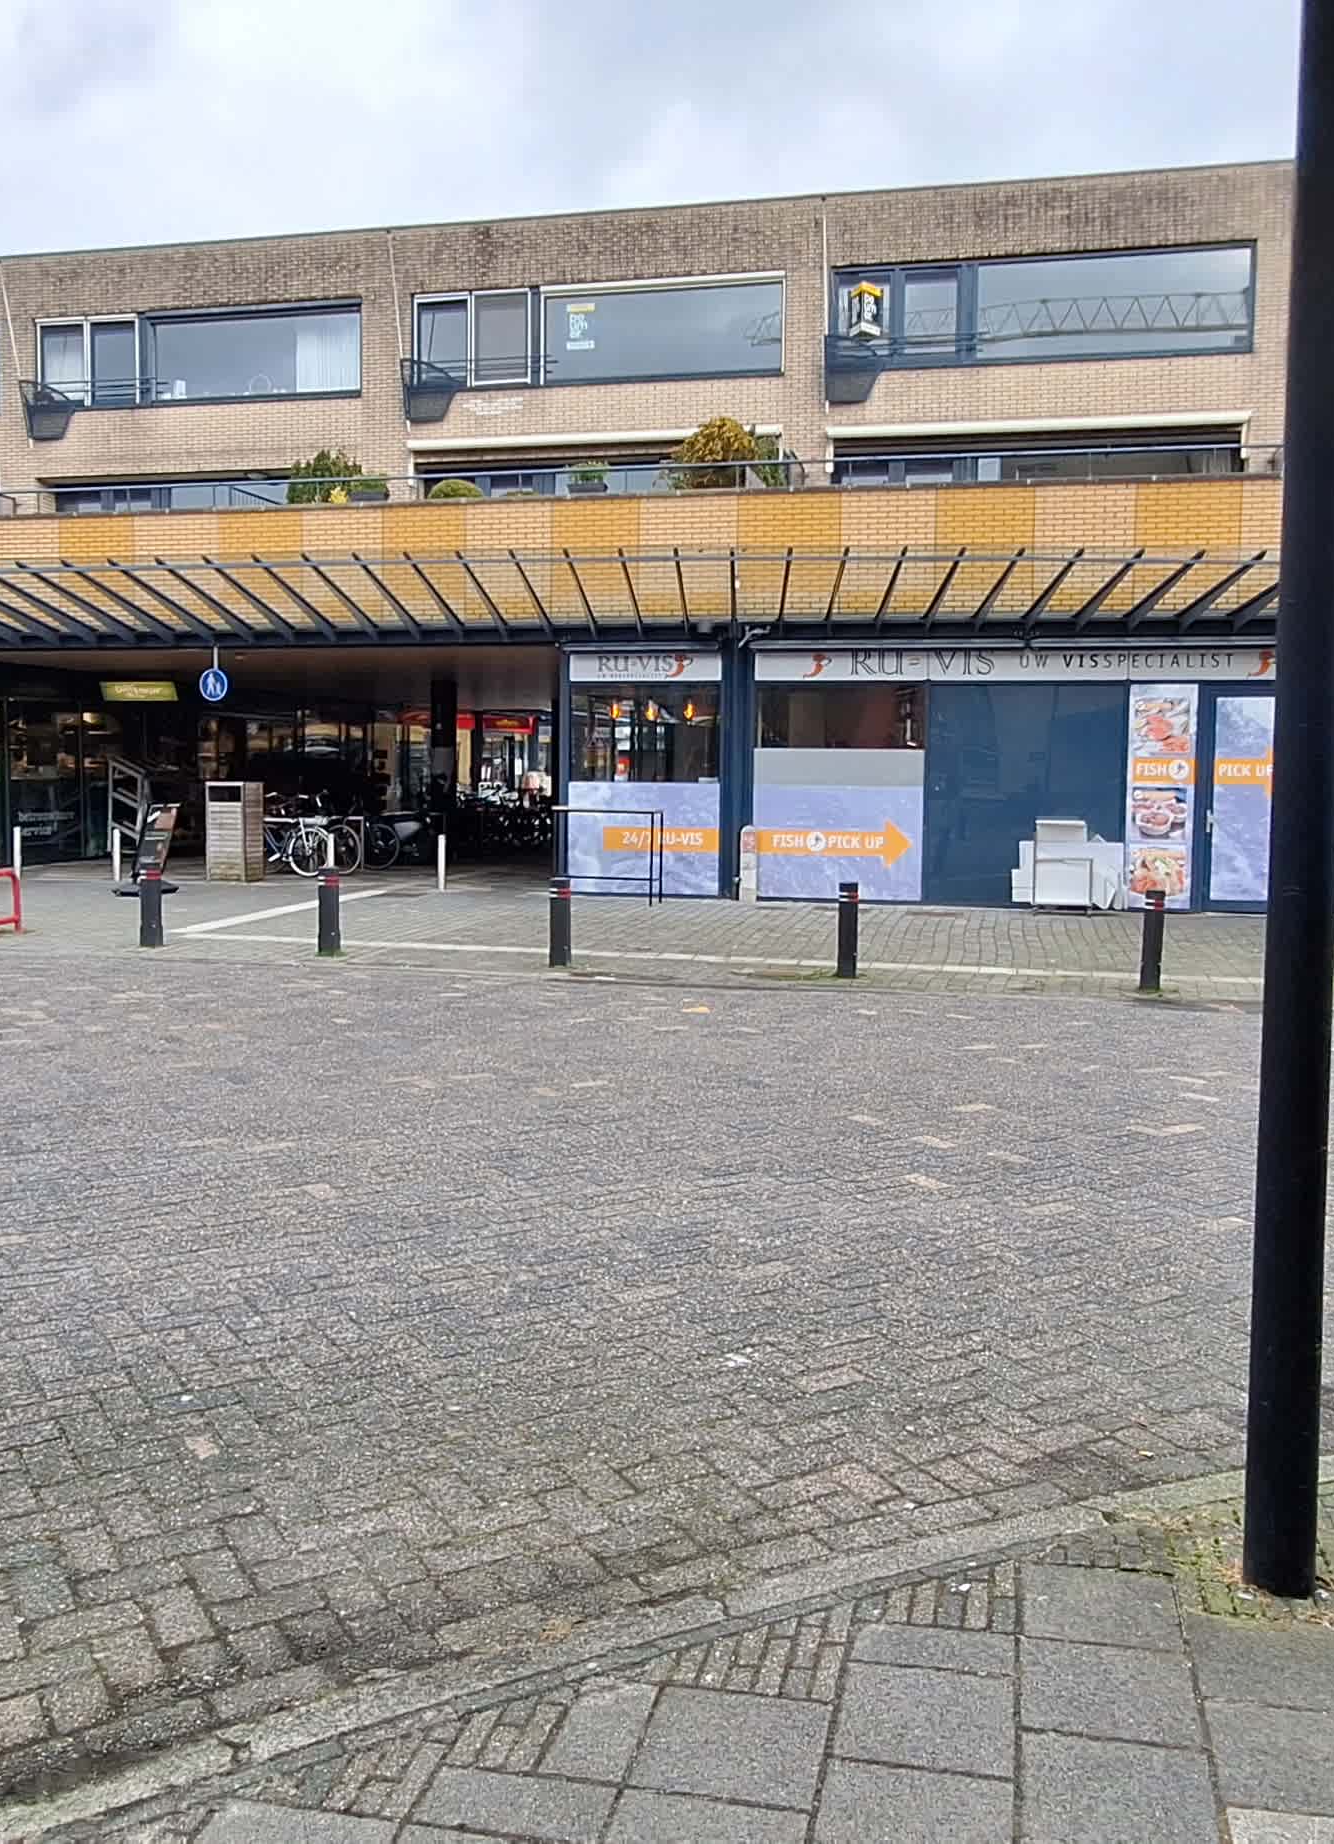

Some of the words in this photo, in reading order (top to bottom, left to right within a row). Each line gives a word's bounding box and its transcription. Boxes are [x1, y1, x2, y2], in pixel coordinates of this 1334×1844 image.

[1019, 653, 1049, 668] UW
[1063, 653, 1234, 668] VISSPECIALIST
[1136, 764, 1167, 776] FISH
[1218, 764, 1251, 776] PICK
[772, 834, 804, 848] FISH
[827, 835, 860, 848] PICK
[864, 836, 884, 848] UP
